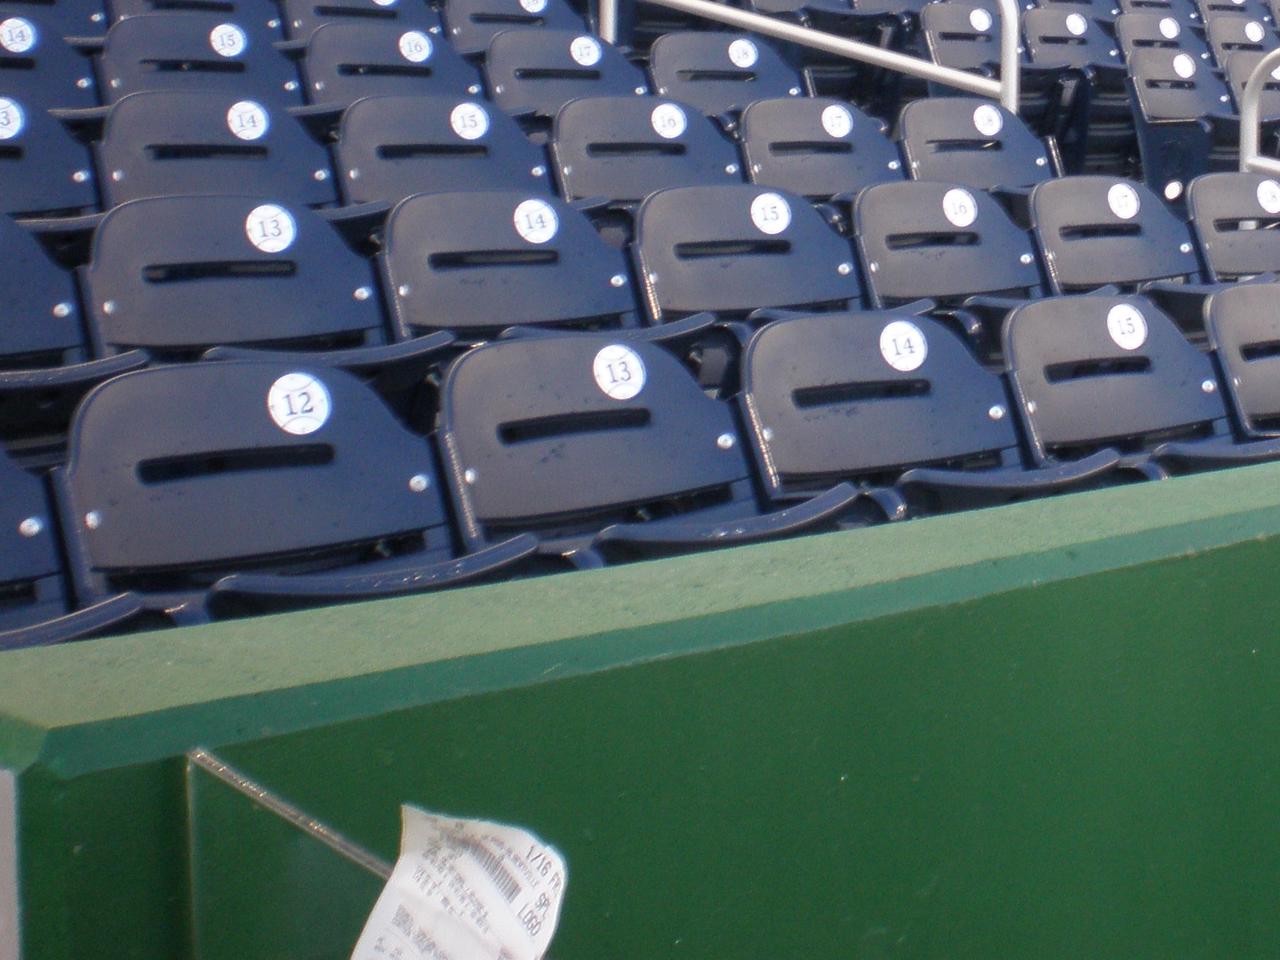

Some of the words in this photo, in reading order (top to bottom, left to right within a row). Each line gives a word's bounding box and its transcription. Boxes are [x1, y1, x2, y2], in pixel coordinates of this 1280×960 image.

[8, 29, 26, 42] 14
[219, 33, 236, 48] 15
[239, 114, 257, 129] 14
[461, 114, 478, 129] 15
[525, 213, 547, 230] 14
[761, 206, 779, 222] 15
[259, 219, 283, 238] 13
[892, 337, 915, 357] 14
[606, 361, 632, 384] 13
[283, 391, 315, 417] 12
[526, 845, 552, 877] 1/16
[518, 903, 542, 936] LOGO
